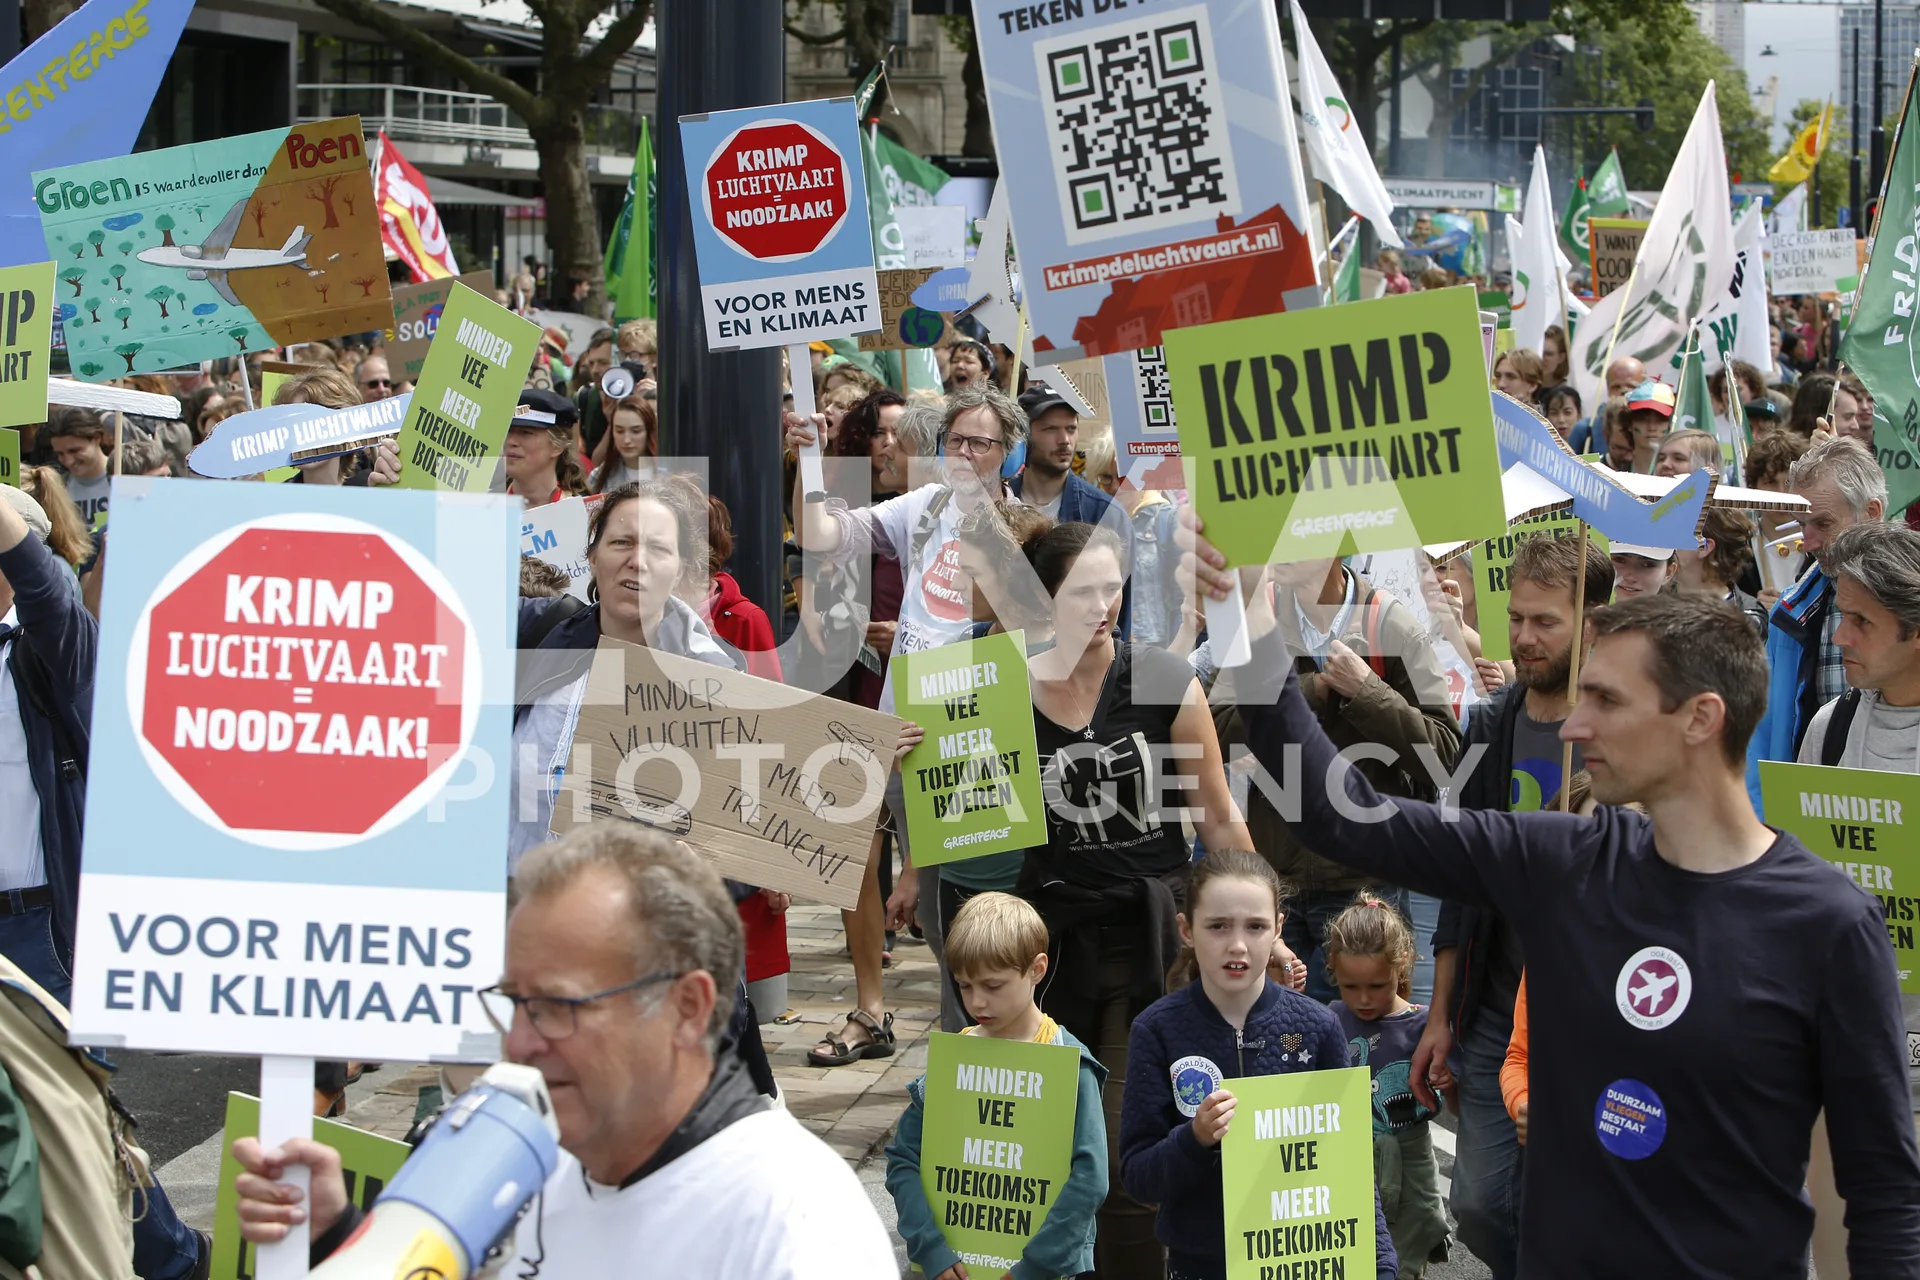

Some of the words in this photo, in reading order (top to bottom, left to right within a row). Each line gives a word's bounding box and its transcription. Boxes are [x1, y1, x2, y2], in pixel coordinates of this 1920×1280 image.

[35, 173, 132, 214] Groen
[241, 162, 268, 181] dan
[286, 133, 360, 170] Poen
[736, 144, 808, 173] KRIMP
[716, 167, 835, 199] LUCHTVAART
[726, 199, 833, 229] NOODZAAK!
[1047, 226, 1279, 290] krimpdeluchtvaart.nl
[1604, 235, 1637, 251] WANT
[714, 291, 786, 316] VOOR
[795, 281, 866, 308] MENS
[718, 320, 752, 338] EN
[761, 304, 868, 334] KLIMAAT
[455, 317, 513, 369] MINDER
[460, 354, 489, 389] VEE
[1199, 331, 1451, 449] KRIMP
[439, 386, 482, 431] MEER
[230, 426, 291, 462] KRIMP
[293, 399, 402, 449] LUCHTVAART
[414, 406, 489, 469] TOEKOMST
[412, 440, 470, 492] BOEREN
[1213, 427, 1461, 503] LUCHTVAART
[1529, 438, 1612, 511] LUCHTVAART
[1290, 507, 1399, 539] GREENPEACE
[224, 574, 394, 629] KRIMP
[165, 632, 448, 688] LUCHTVAART
[624, 676, 729, 716] MINDER
[920, 661, 998, 699] MINDER
[944, 693, 980, 722] VEE
[173, 706, 429, 759] NOODZAAK!
[609, 714, 763, 763] VLUCHTEN,
[939, 727, 993, 760] MEER
[917, 750, 1021, 792] TOEKOMST
[767, 762, 837, 823] MEER
[933, 782, 1012, 819] BOEREN
[1800, 792, 1903, 825] MINDER
[721, 784, 850, 885] TREINEN!
[944, 826, 1011, 850] GREENPEACE
[1830, 824, 1877, 852] VEE
[108, 912, 279, 960] VOOR
[303, 921, 473, 970] MENS
[104, 968, 182, 1013] EN
[209, 973, 473, 1026] KLIMAAT
[956, 1063, 1043, 1099] MINDER
[978, 1098, 1015, 1128] VEE
[1254, 1102, 1340, 1140] MINDER
[1602, 1110, 1647, 1135] BESTAAT
[1605, 1099, 1646, 1122] VLIEGEN
[1607, 1089, 1661, 1118] DUURZAAM
[1599, 1121, 1621, 1136] NIET
[962, 1137, 1023, 1170] MEER
[1280, 1140, 1318, 1173] VEE
[935, 1165, 1050, 1205] TOEKOMST
[1270, 1185, 1331, 1221] MEER
[945, 1199, 1031, 1237] BOEREN
[1243, 1217, 1358, 1261] TOEKOMST
